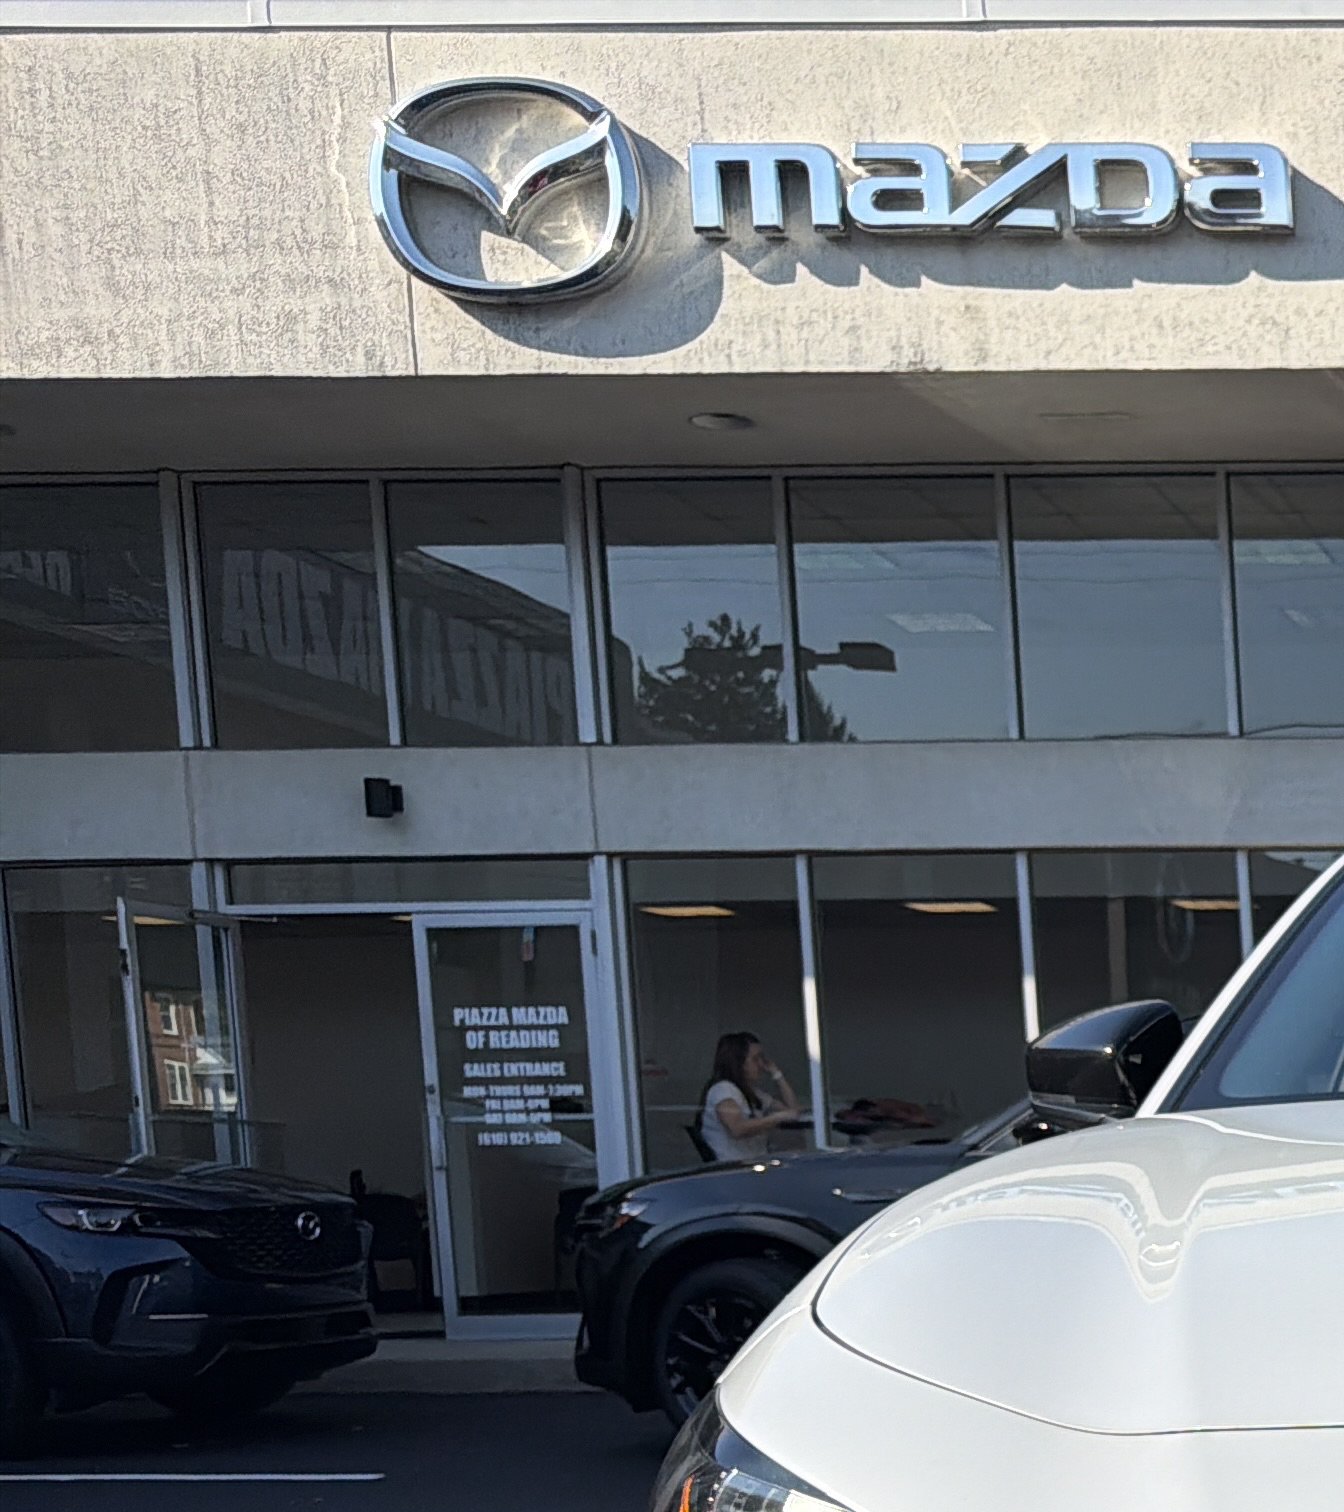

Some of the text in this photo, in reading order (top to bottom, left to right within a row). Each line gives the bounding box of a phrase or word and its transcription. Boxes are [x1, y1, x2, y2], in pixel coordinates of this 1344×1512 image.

[453, 1006, 569, 1027] PIAZZA MAZDA
[466, 1030, 560, 1049] OF READING
[463, 1062, 566, 1077] SALES ENTRANCE
